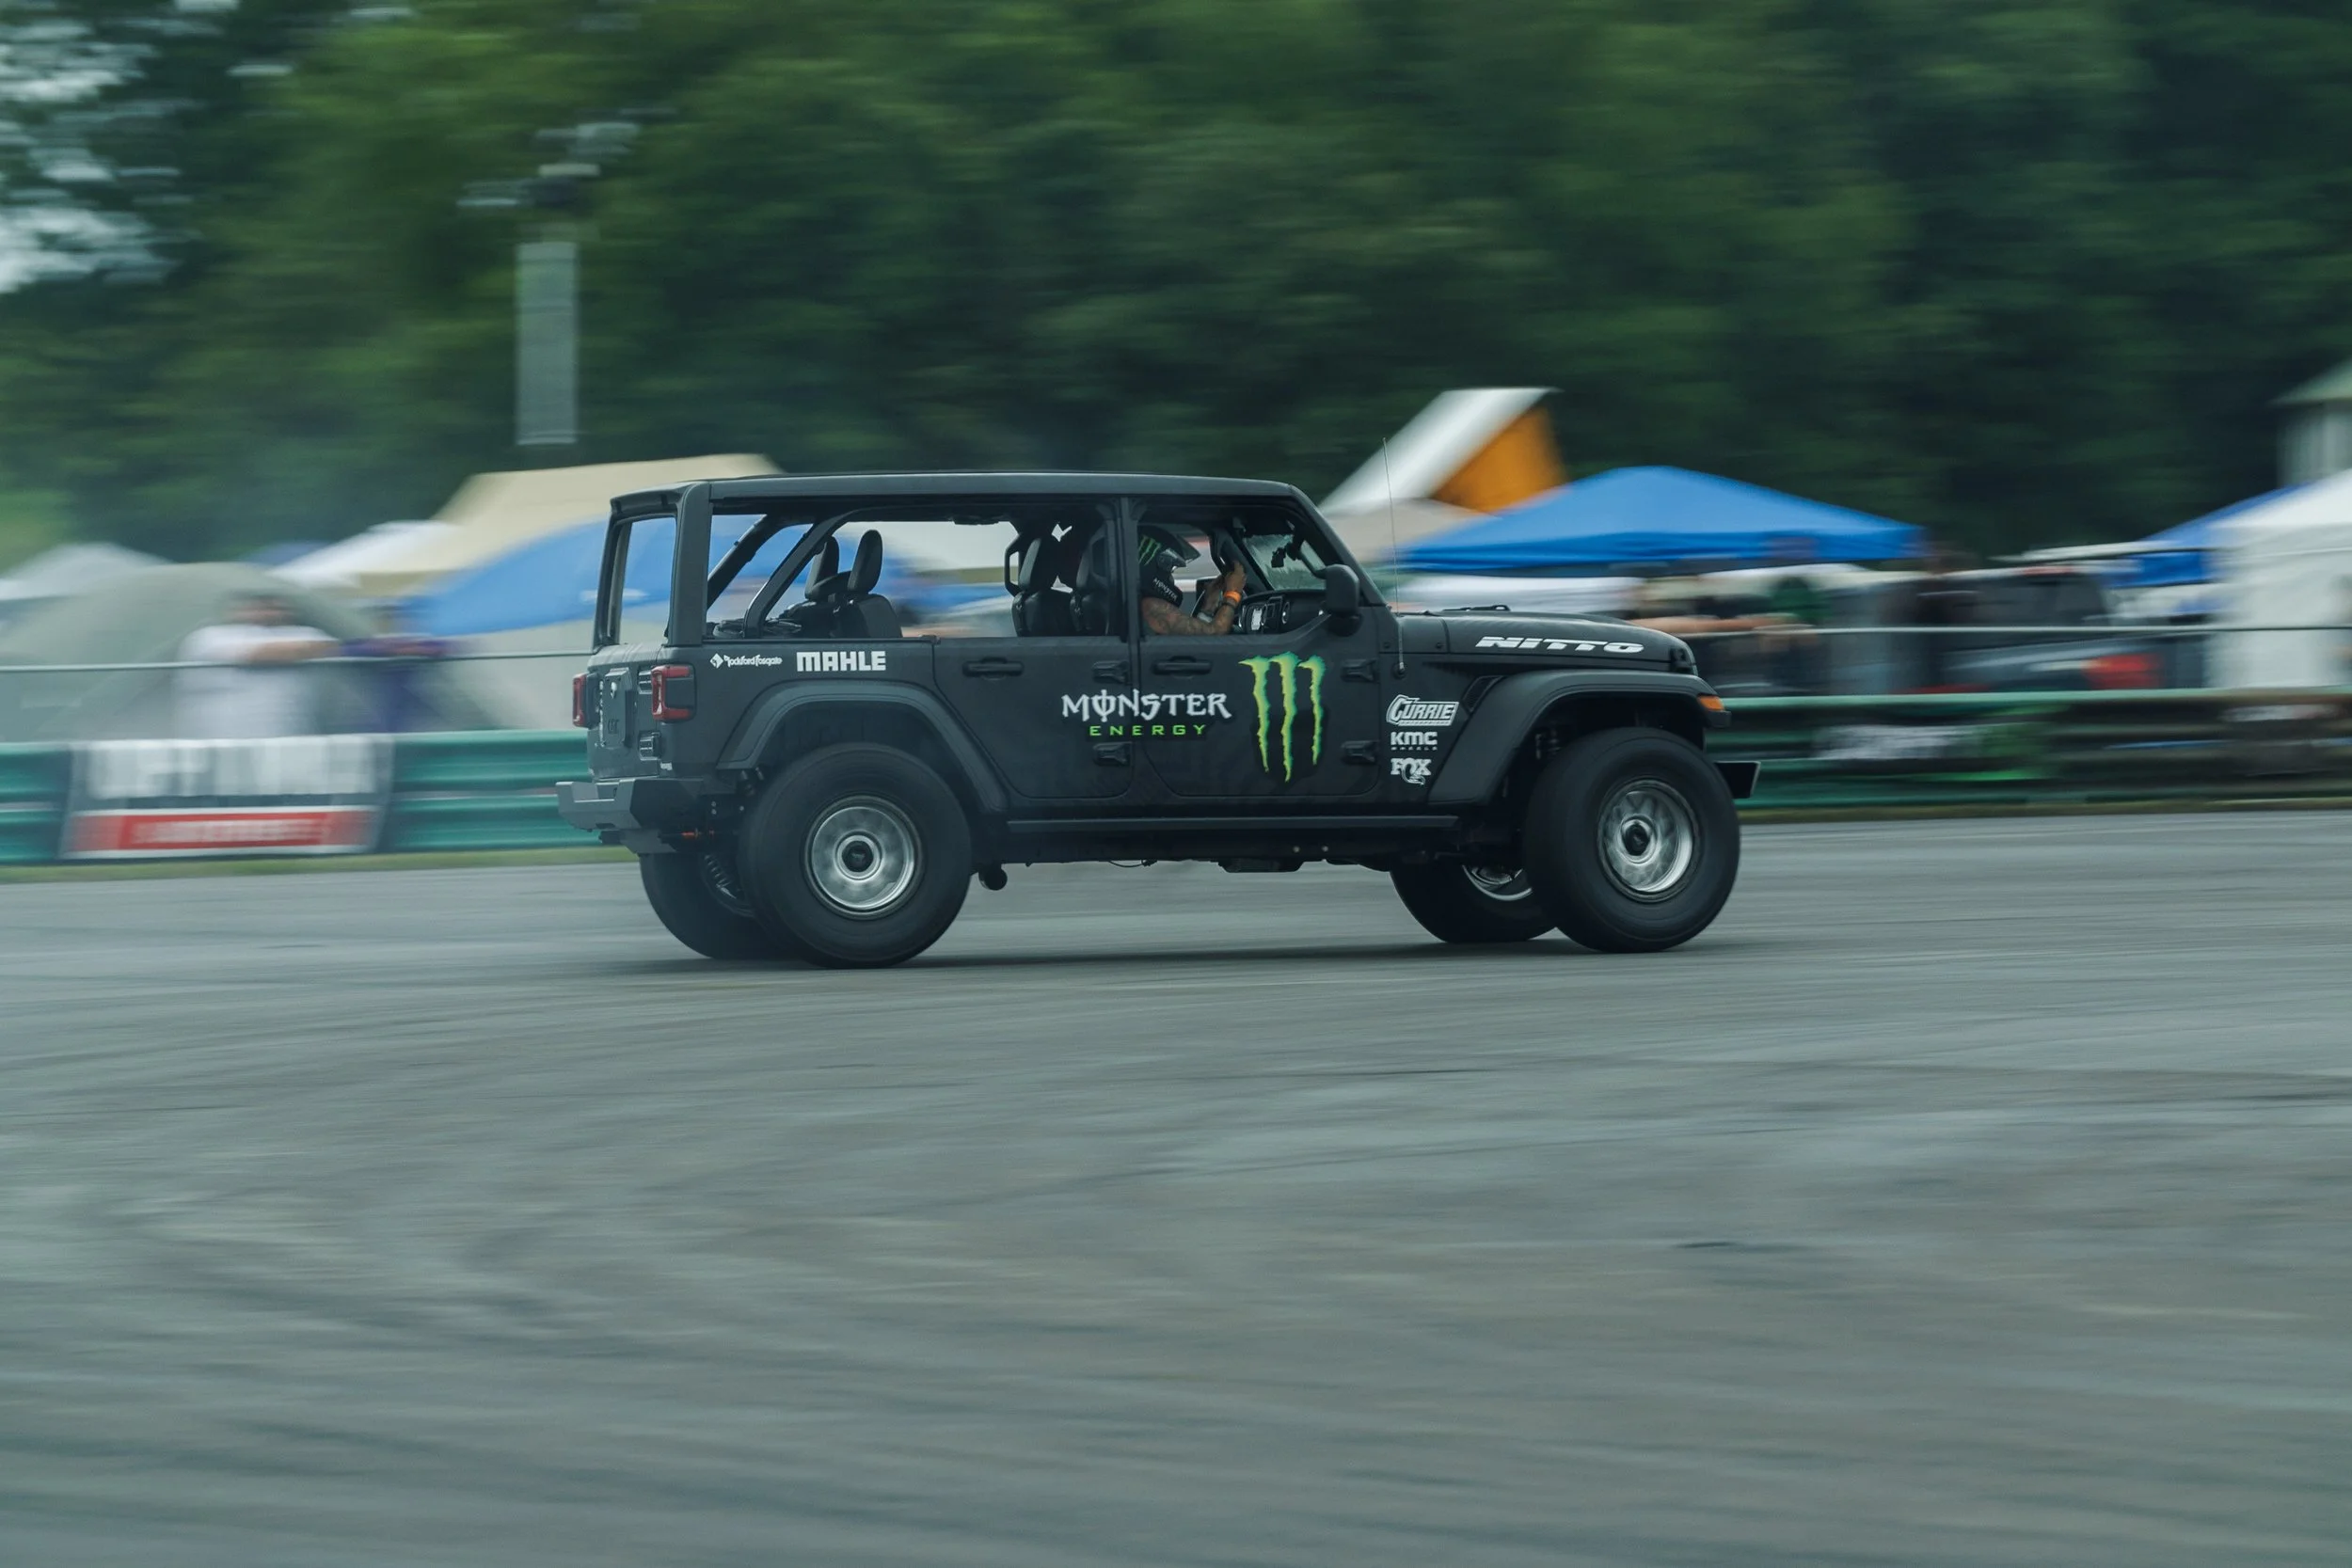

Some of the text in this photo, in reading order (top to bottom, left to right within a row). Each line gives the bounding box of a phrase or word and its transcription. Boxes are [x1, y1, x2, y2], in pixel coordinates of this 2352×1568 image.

[1475, 636, 1645, 654] NITTO
[796, 651, 886, 672] MAHLE
[1061, 689, 1232, 722] MONSTER
[1391, 697, 1454, 721] CURRIE
[1089, 724, 1206, 736] ENERGY
[1391, 731, 1438, 745] KMC
[1391, 757, 1432, 784] FOX
